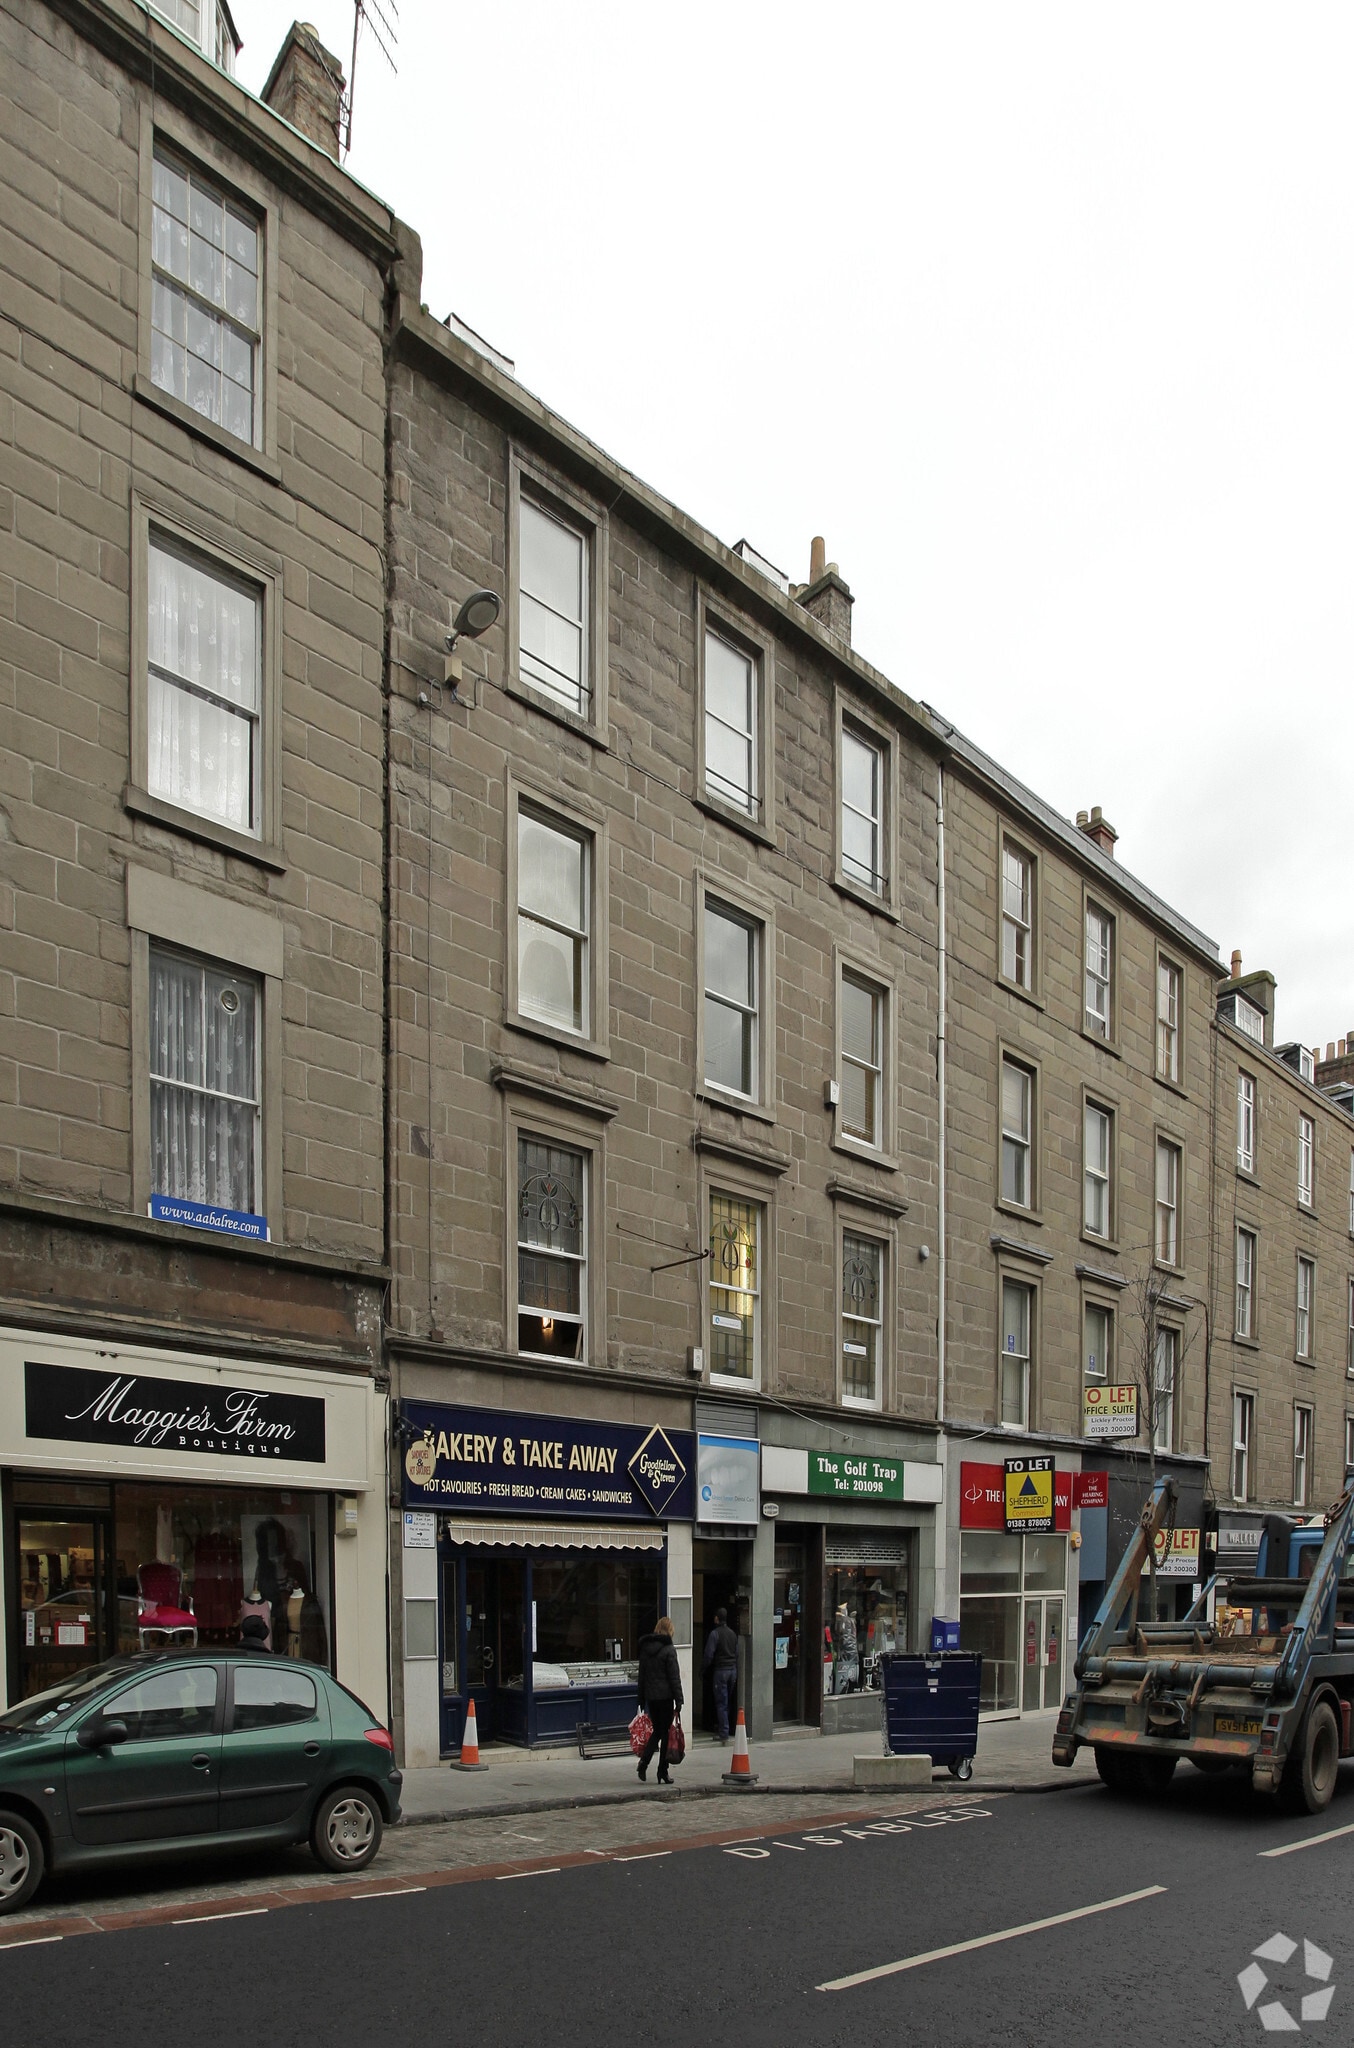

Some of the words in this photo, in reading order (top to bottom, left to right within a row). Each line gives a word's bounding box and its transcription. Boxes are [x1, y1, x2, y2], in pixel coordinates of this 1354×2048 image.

[1085, 1388, 1101, 1404] O
[1109, 1387, 1134, 1403] LET
[65, 1376, 216, 1445] Maggie's
[213, 1390, 295, 1440] Farm
[1112, 1405, 1134, 1414] SUITE
[179, 1436, 281, 1454] Boutique
[502, 1437, 516, 1465] &
[520, 1439, 563, 1469] TAKE
[568, 1444, 618, 1473] AWAY
[640, 1453, 677, 1474] Goodfellow
[817, 1457, 839, 1474] The
[844, 1460, 868, 1476] Golf
[872, 1463, 897, 1481] Trap
[1007, 1460, 1024, 1472] TO
[1028, 1458, 1050, 1471] LET
[652, 1469, 676, 1489] Steven
[833, 1478, 849, 1490] Tel:
[853, 1480, 884, 1493] 201098
[441, 1480, 482, 1495] SAVOURIES
[488, 1483, 510, 1497] FRESH
[511, 1485, 535, 1498] BREAD
[540, 1486, 564, 1499] CREAM
[565, 1488, 586, 1501] CAKES
[592, 1490, 632, 1504] SANDWICHES
[985, 1489, 1000, 1503] THE
[1009, 1496, 1049, 1506] SHEPHERD
[1012, 1509, 1046, 1518] Commercial
[1007, 1520, 1026, 1528] 01382
[1028, 1518, 1051, 1527] 878005
[1173, 1530, 1198, 1549] LET
[1228, 1533, 1258, 1545] WALKER
[722, 1807, 993, 1859] DISABLED
